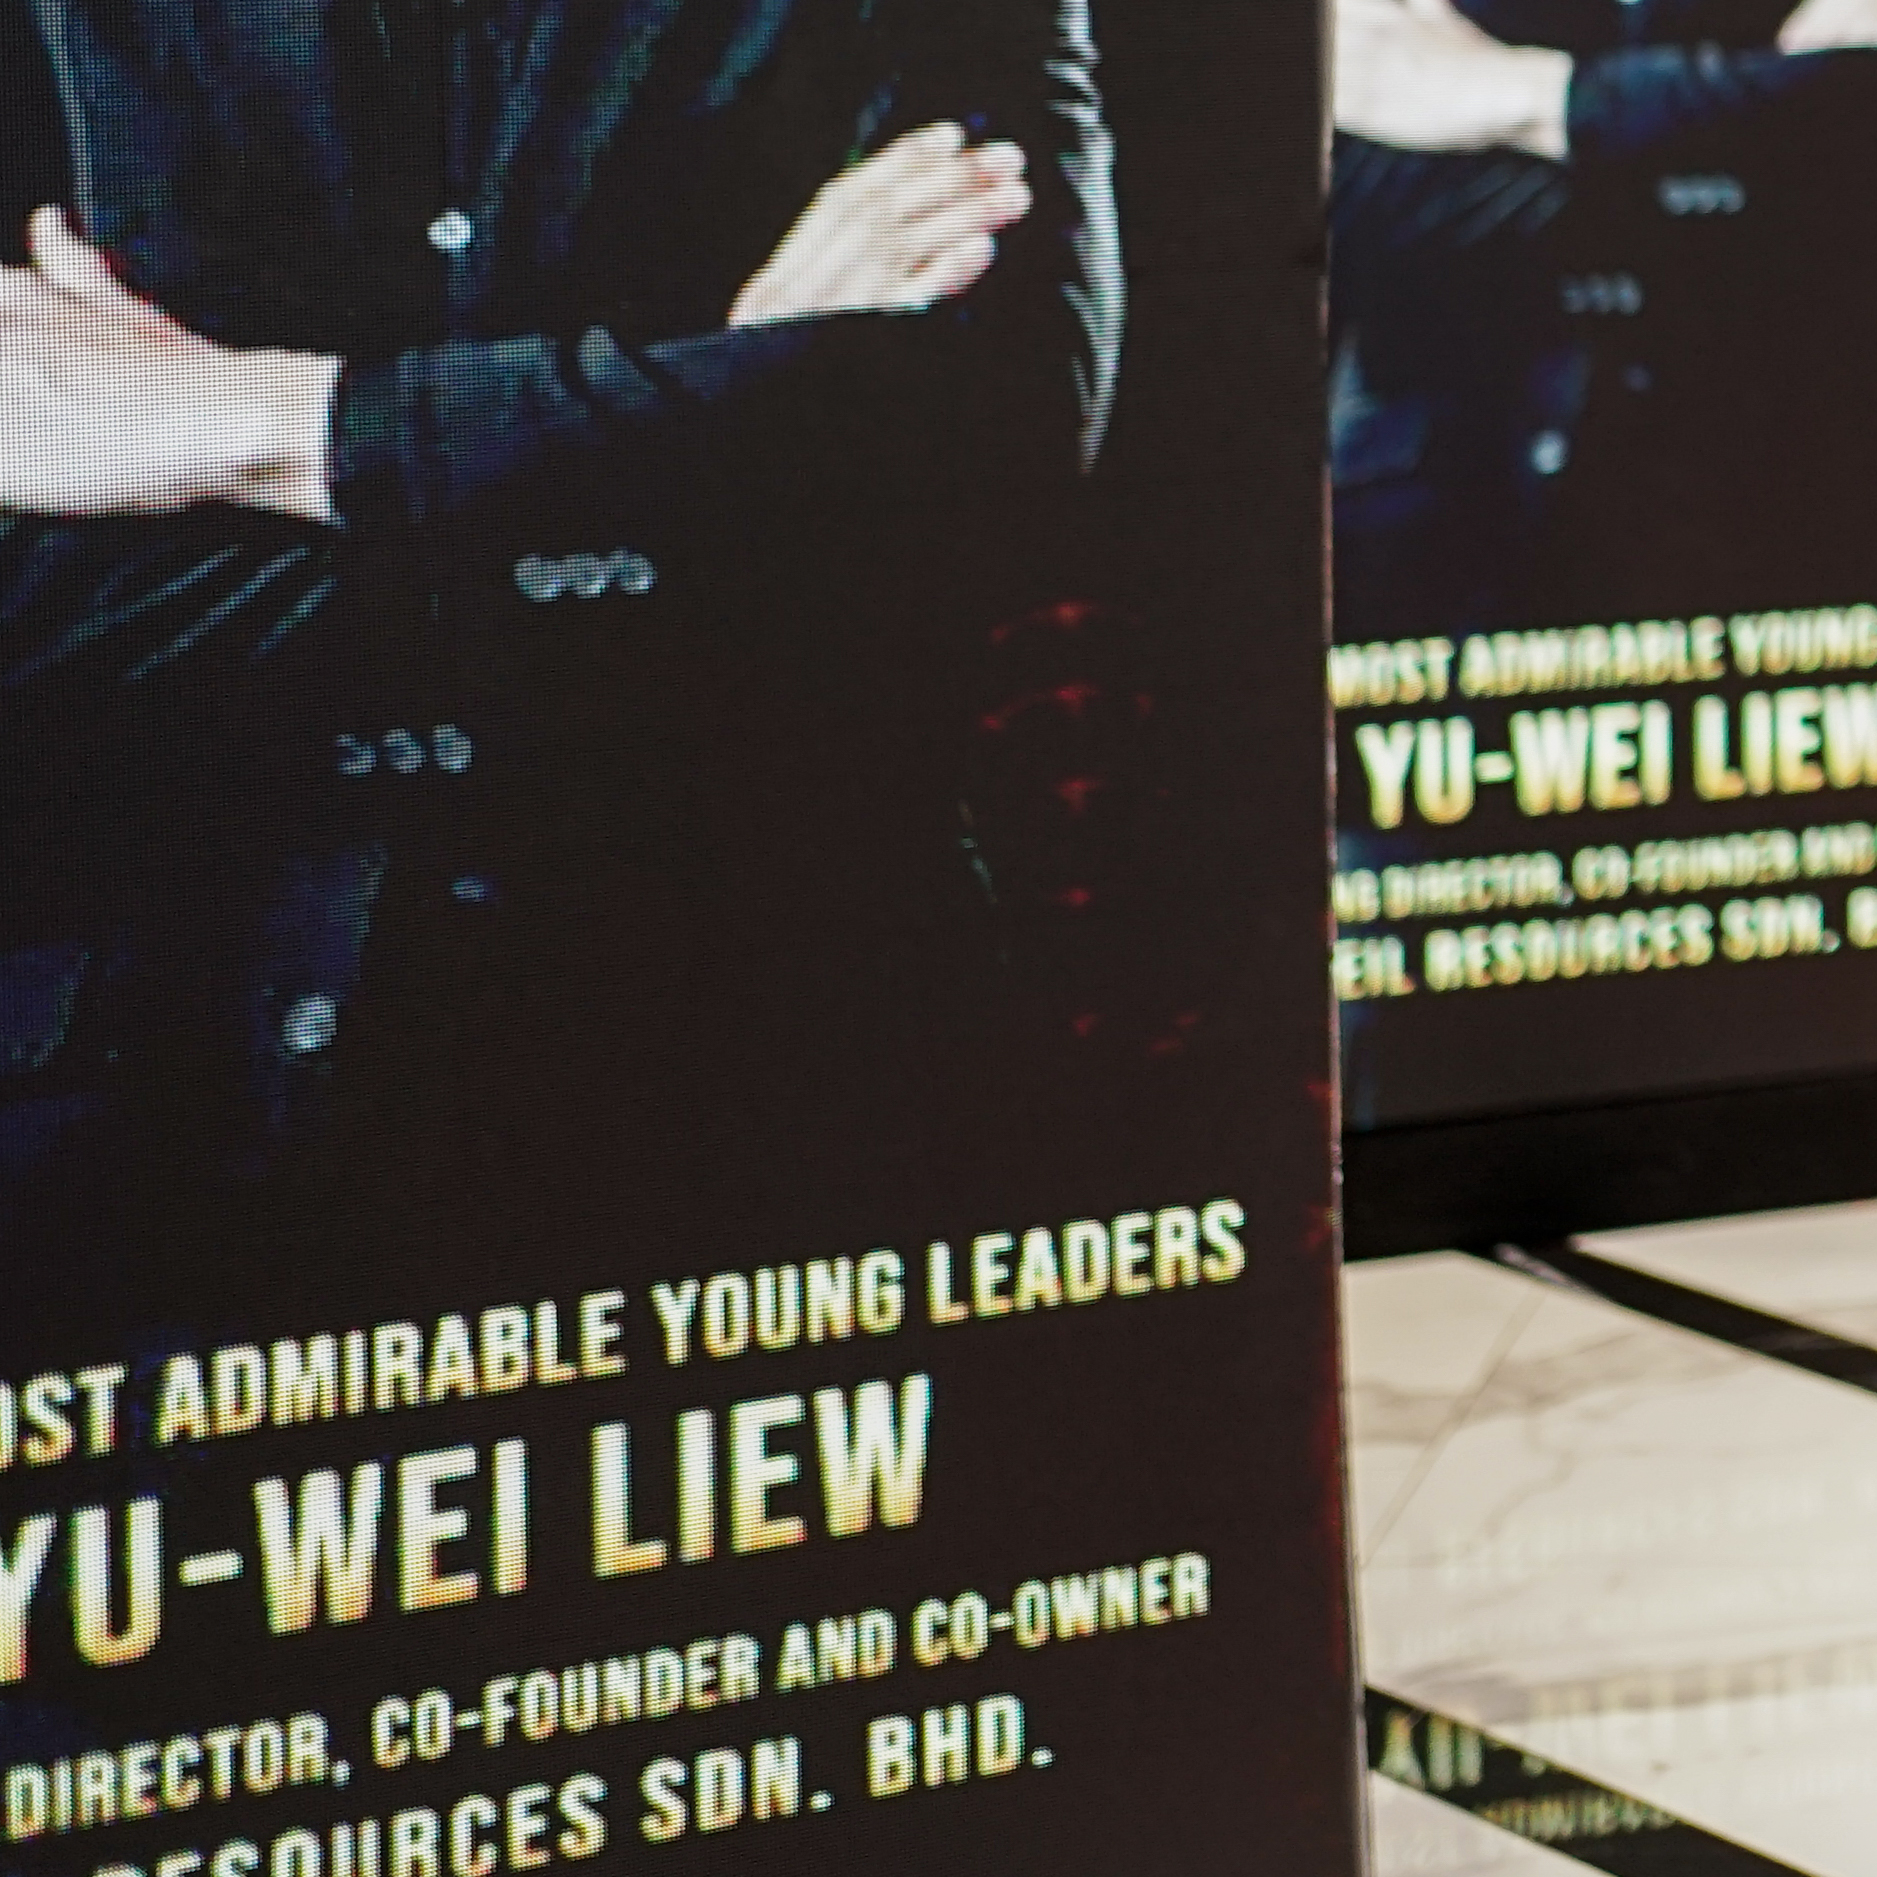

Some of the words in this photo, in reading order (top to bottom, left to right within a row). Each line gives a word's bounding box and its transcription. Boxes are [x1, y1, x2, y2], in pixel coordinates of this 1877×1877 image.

[1459, 615, 1724, 697] ADMIRABLE
[1355, 699, 1673, 829] YU-WEI
[1330, 935, 1416, 1002] EIL
[1423, 903, 1714, 991] RESOURCES
[1720, 892, 1841, 962] SDN.
[157, 1280, 625, 1444] ADMIRABLE
[651, 1250, 904, 1364] YOUNG
[928, 1199, 1246, 1324] LEADERS
[0, 1439, 527, 1684] YU-WEI
[592, 1373, 931, 1577] LIEW
[5, 1711, 350, 1842] DIRECTOR,
[372, 1635, 760, 1768] CO-FOUNDER
[778, 1609, 896, 1690] AND
[912, 1552, 1209, 1666] CO-OWNER
[640, 1737, 832, 1841] SDN.
[867, 1695, 1053, 1797] BHD.
